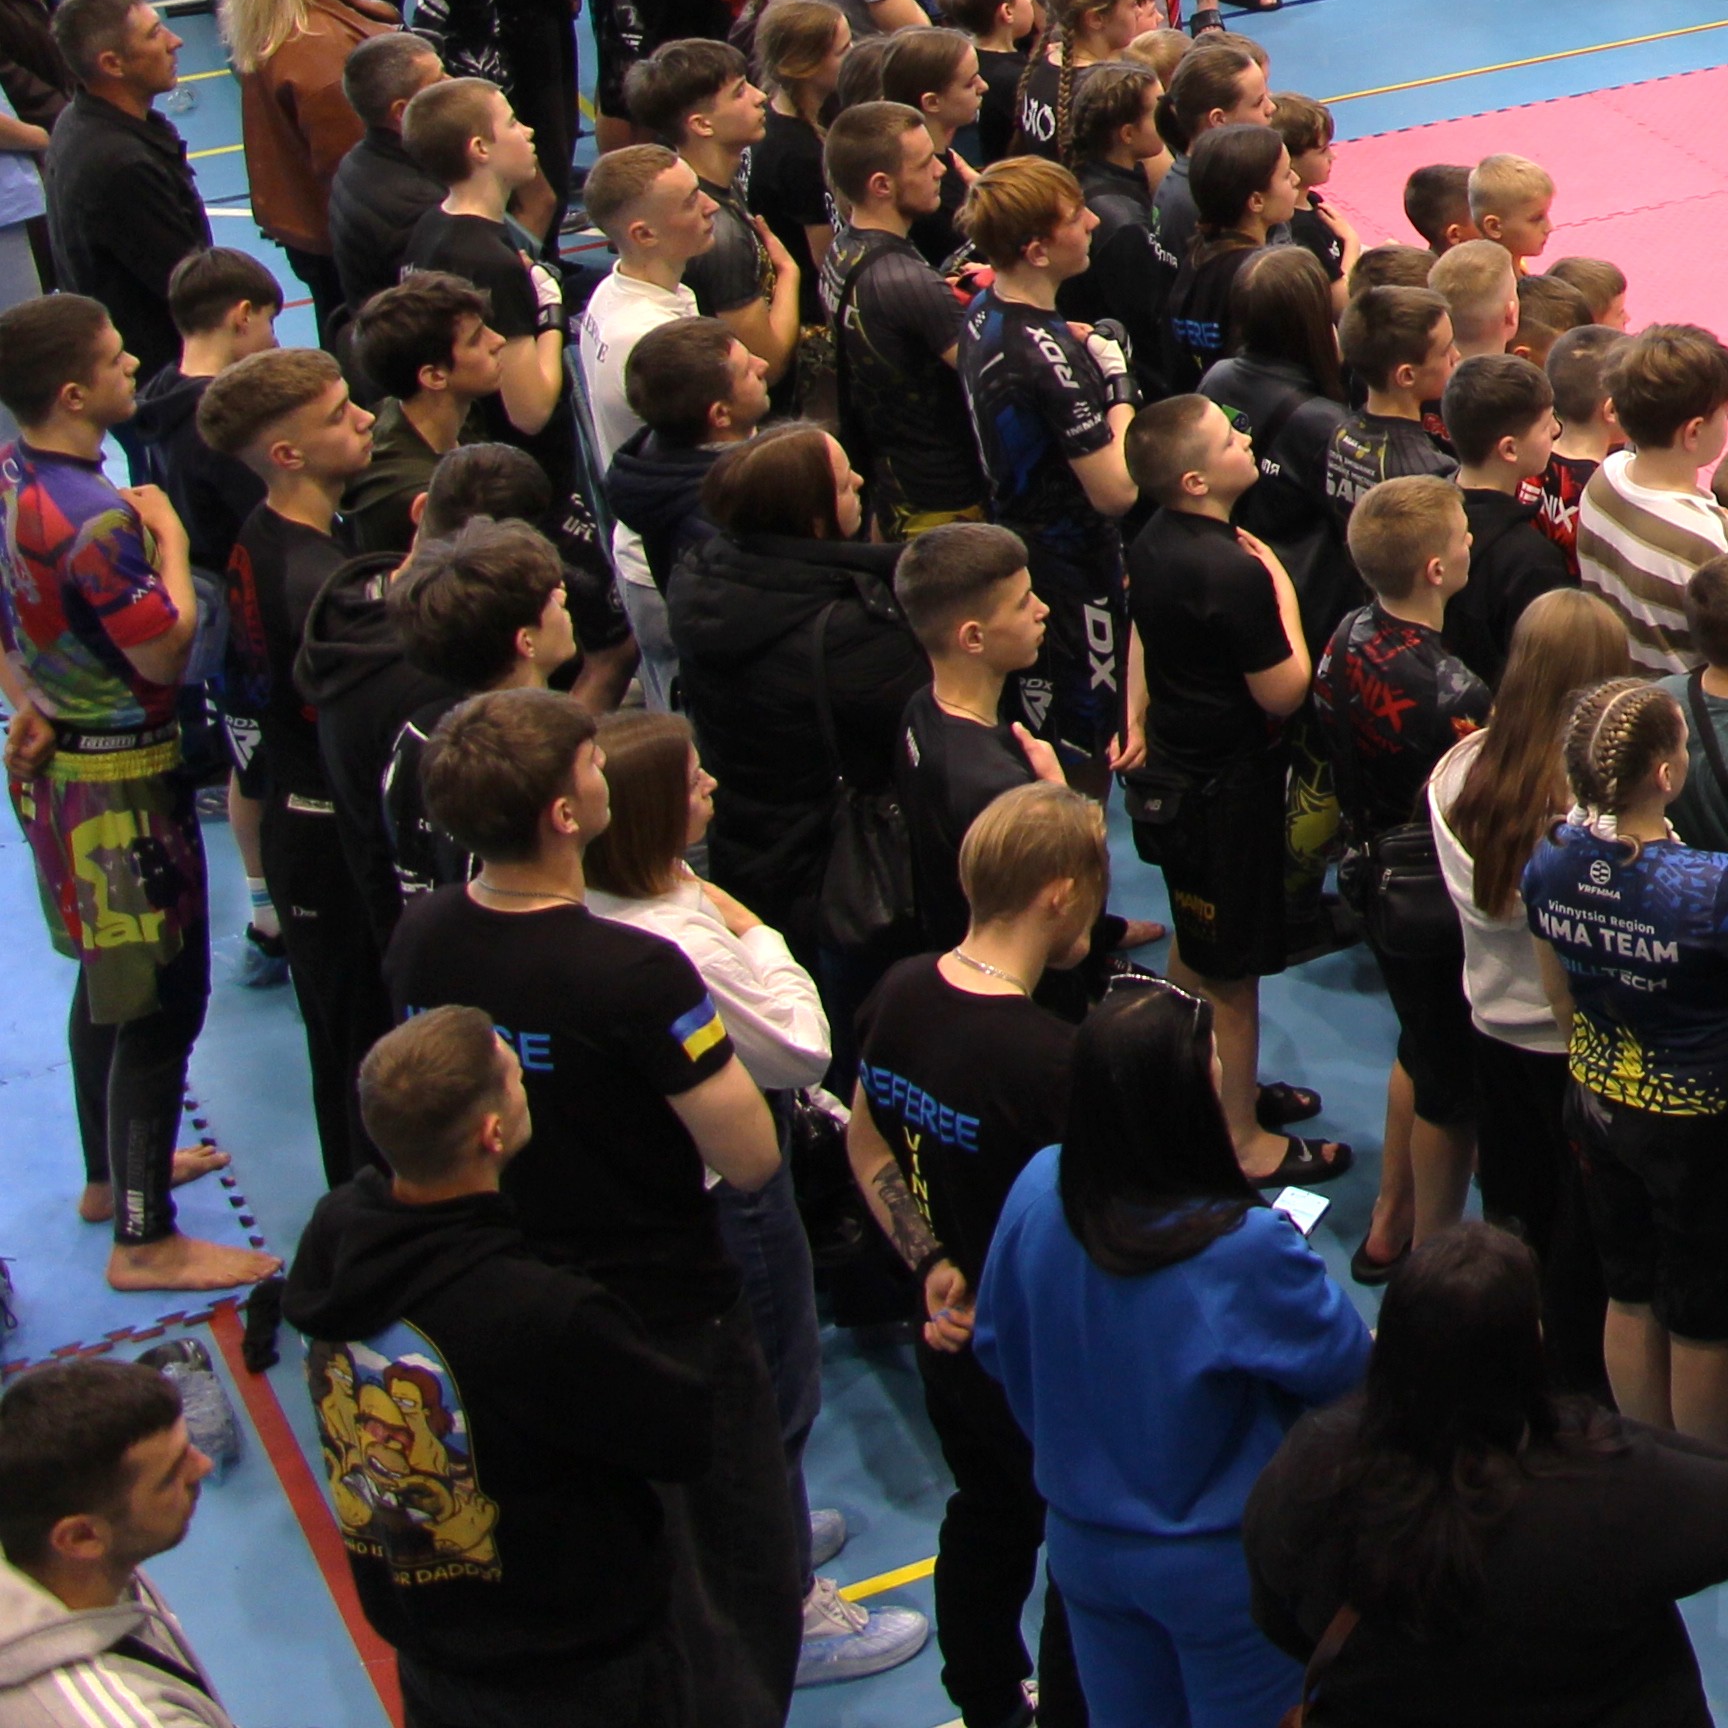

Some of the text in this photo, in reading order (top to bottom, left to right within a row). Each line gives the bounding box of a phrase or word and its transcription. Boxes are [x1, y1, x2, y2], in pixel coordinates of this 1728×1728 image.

[1024, 325, 1081, 390] RDX
[1083, 596, 1118, 693] DX
[1537, 906, 1680, 964] MMA TEAM
[1547, 898, 1656, 936] Vinnytsia Region
